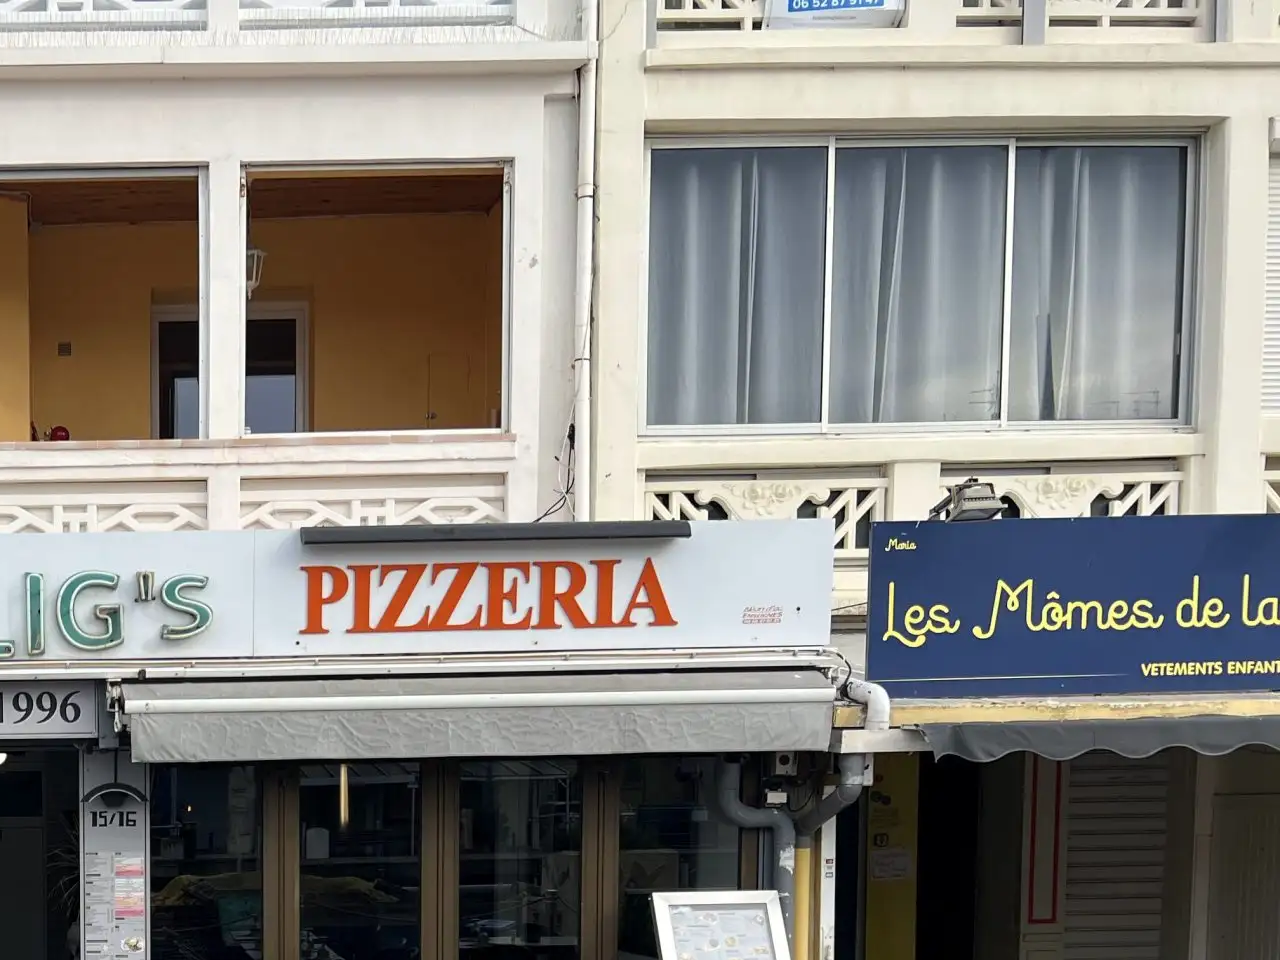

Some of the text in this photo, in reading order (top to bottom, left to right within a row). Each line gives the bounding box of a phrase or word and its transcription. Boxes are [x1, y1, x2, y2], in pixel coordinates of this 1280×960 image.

[884, 538, 917, 552] Maria
[298, 556, 679, 635] PIZZERIA
[882, 573, 1280, 648] Les Mômes de la
[1140, 661, 1224, 677] VETEMENTS
[89, 810, 137, 828] 15/16
